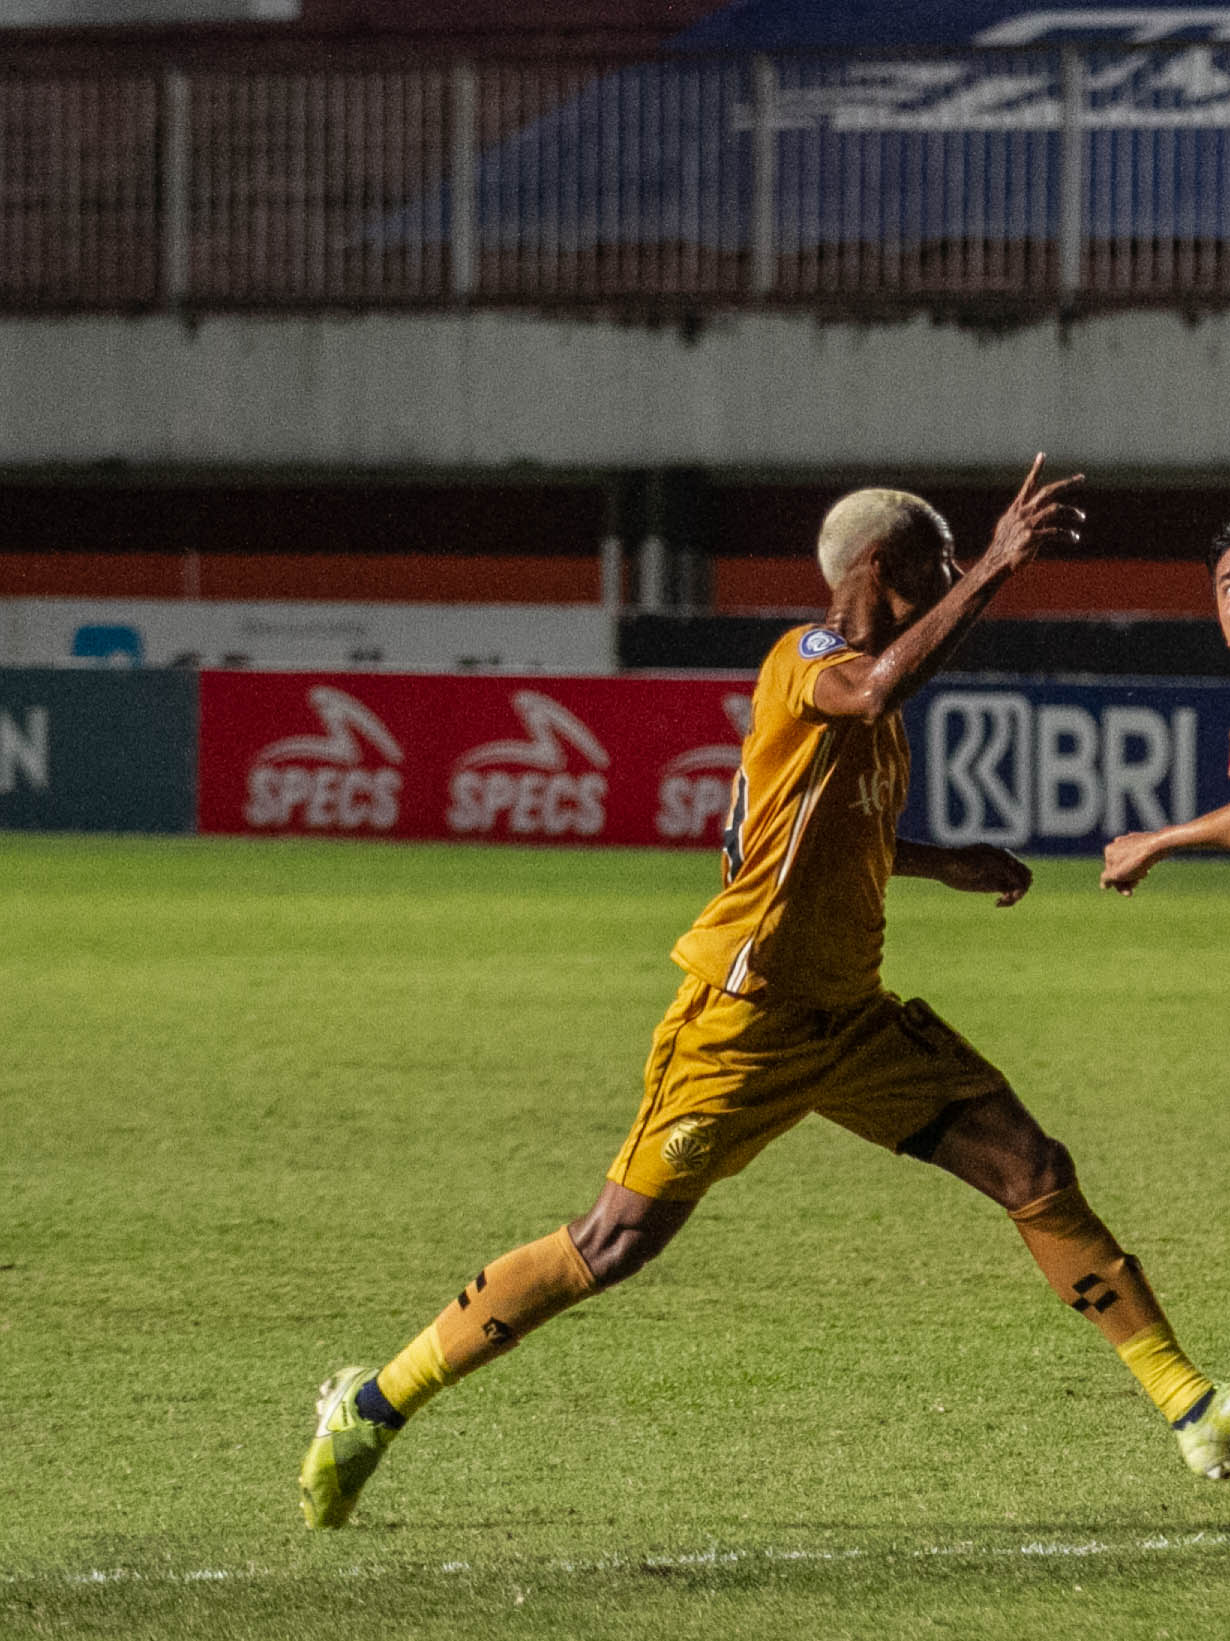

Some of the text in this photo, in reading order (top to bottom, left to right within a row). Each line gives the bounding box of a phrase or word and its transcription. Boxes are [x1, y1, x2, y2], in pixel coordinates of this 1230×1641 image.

[245, 767, 401, 829] SPECS
[447, 770, 608, 835] SPECS
[1037, 704, 1197, 838] BRI
